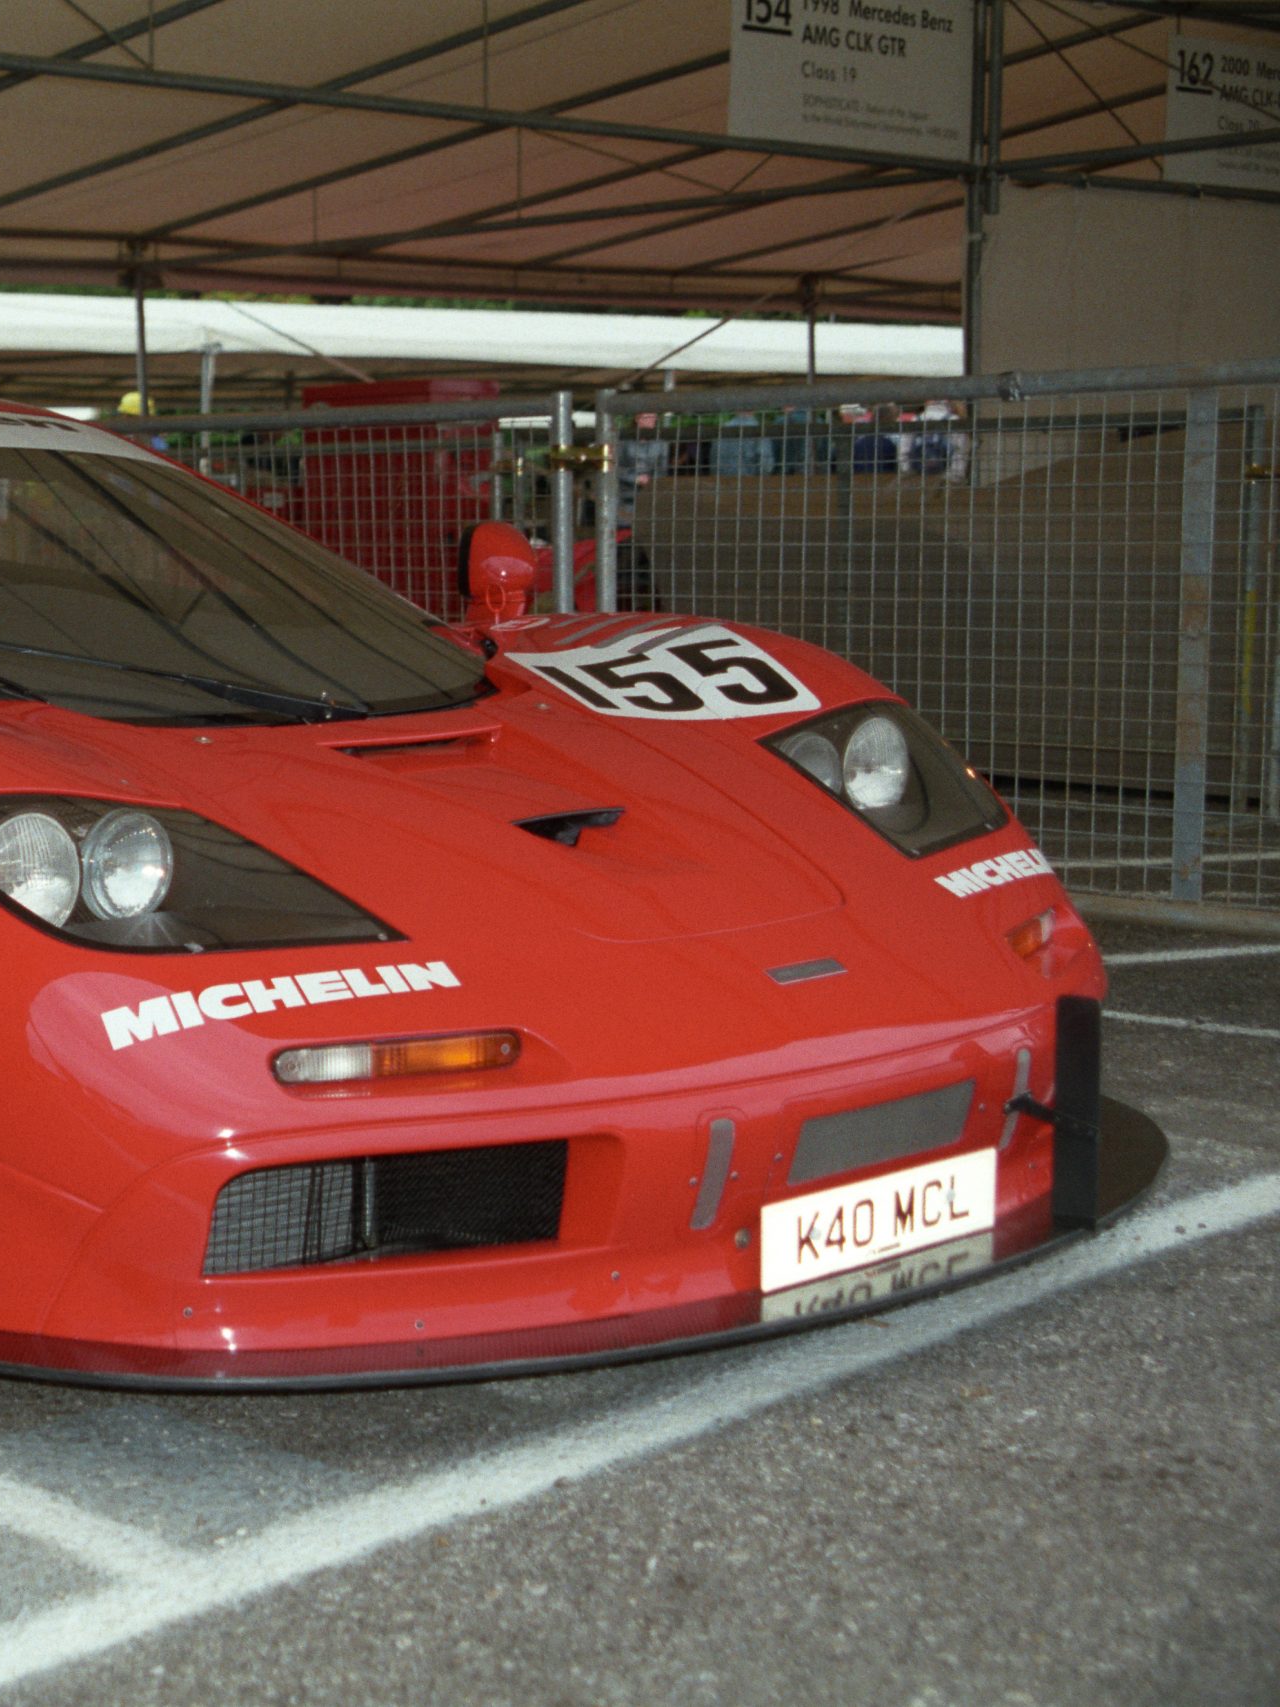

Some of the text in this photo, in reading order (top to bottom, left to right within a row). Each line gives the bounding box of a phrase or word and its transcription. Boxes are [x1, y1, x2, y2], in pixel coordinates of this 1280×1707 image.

[849, 0, 917, 28] Mercedes
[921, 10, 953, 33] Benz
[802, 25, 907, 57] AMG CLK GTR
[801, 60, 857, 82] Class 19
[1177, 49, 1214, 85] 162
[1221, 55, 1250, 77] 2000
[1219, 84, 1249, 102] AMG
[531, 638, 799, 712] 155
[101, 961, 461, 1051] MICHELIN
[797, 1174, 970, 1265] K40 MCL
